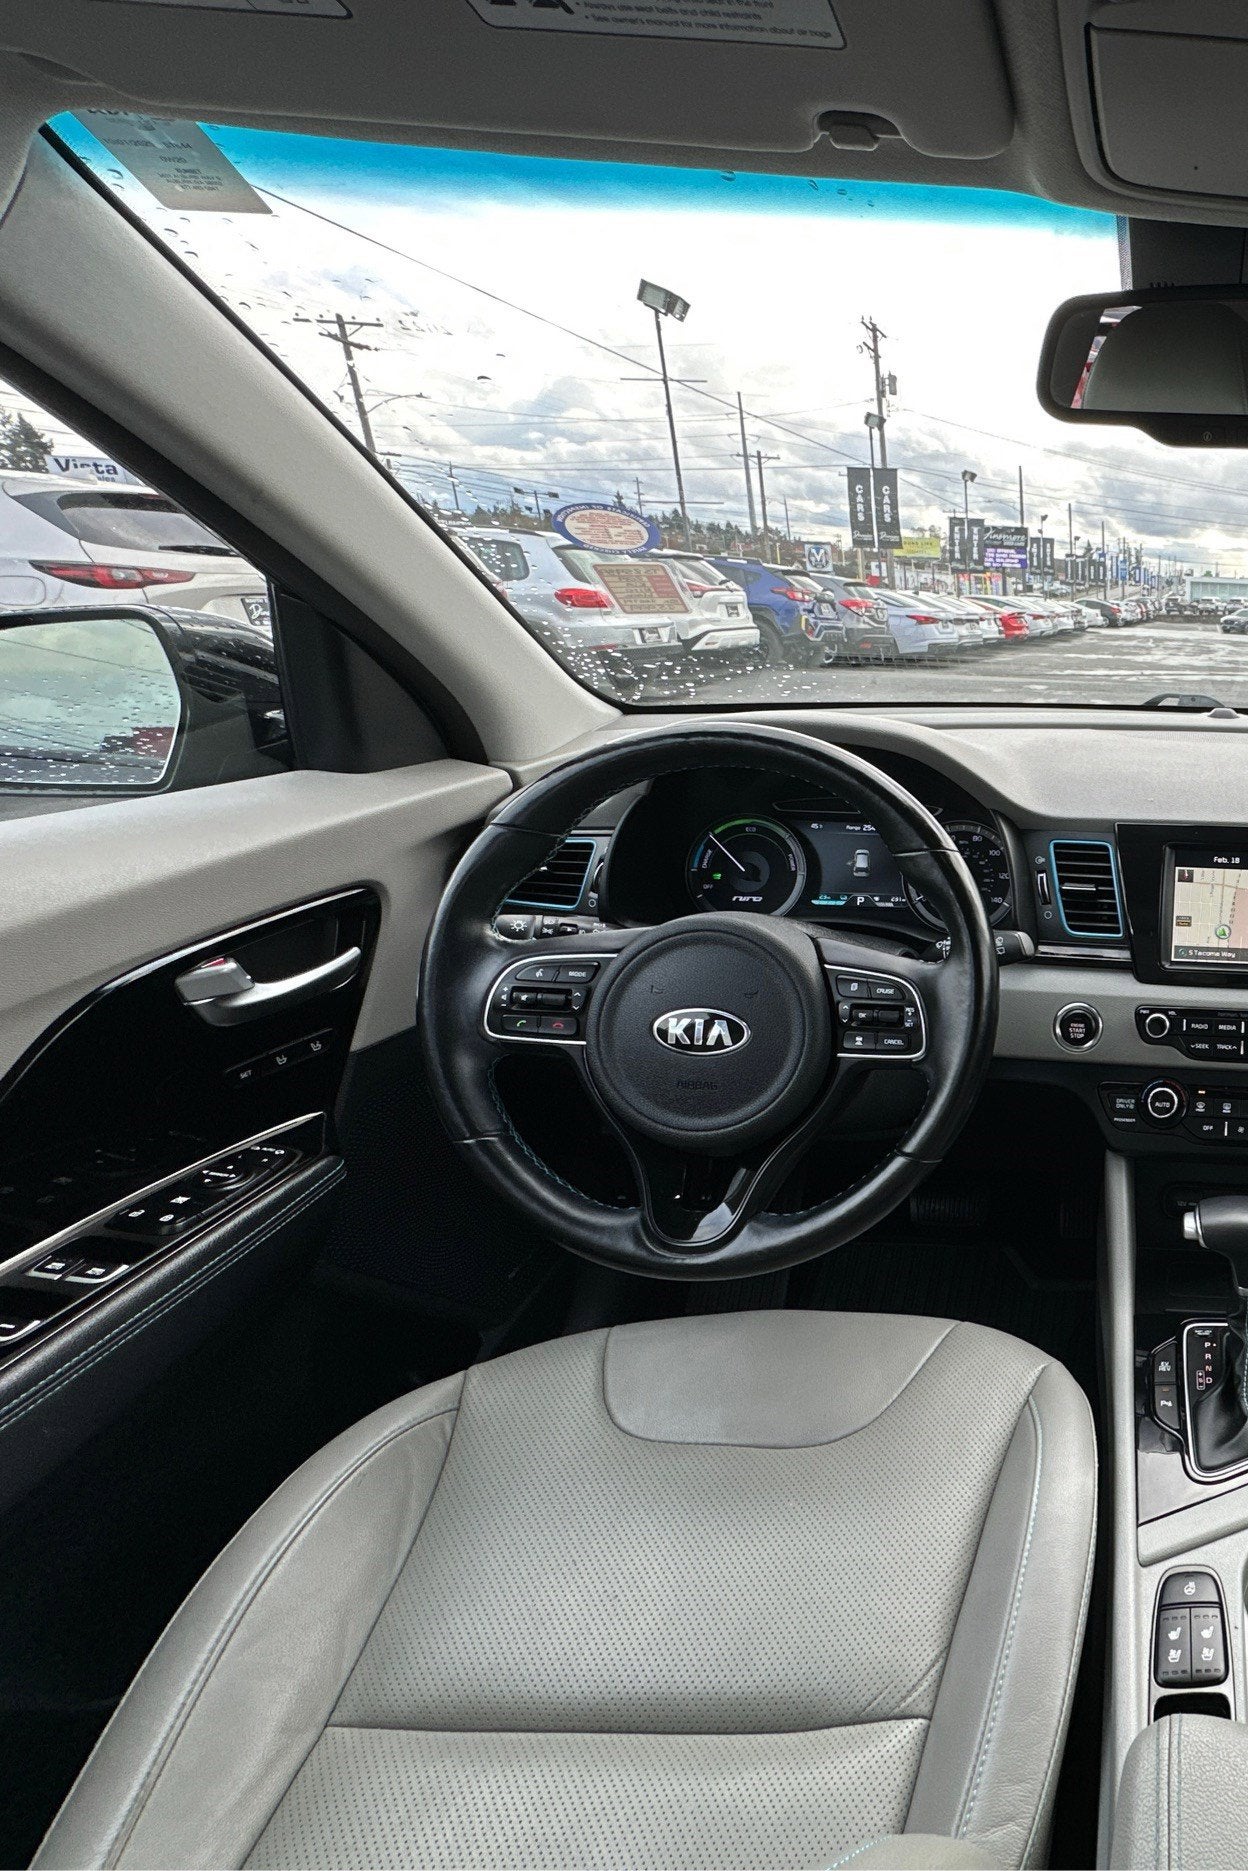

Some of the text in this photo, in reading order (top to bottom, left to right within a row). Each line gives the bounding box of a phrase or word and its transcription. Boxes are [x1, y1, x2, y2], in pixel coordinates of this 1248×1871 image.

[855, 484, 866, 522] CARS
[881, 485, 892, 523] CARS
[1213, 856, 1241, 864] Feb. 18
[856, 897, 865, 906] P
[667, 1017, 733, 1046] KIA
[1217, 1043, 1233, 1051] TRACK
[1154, 1101, 1171, 1109] AUTO
